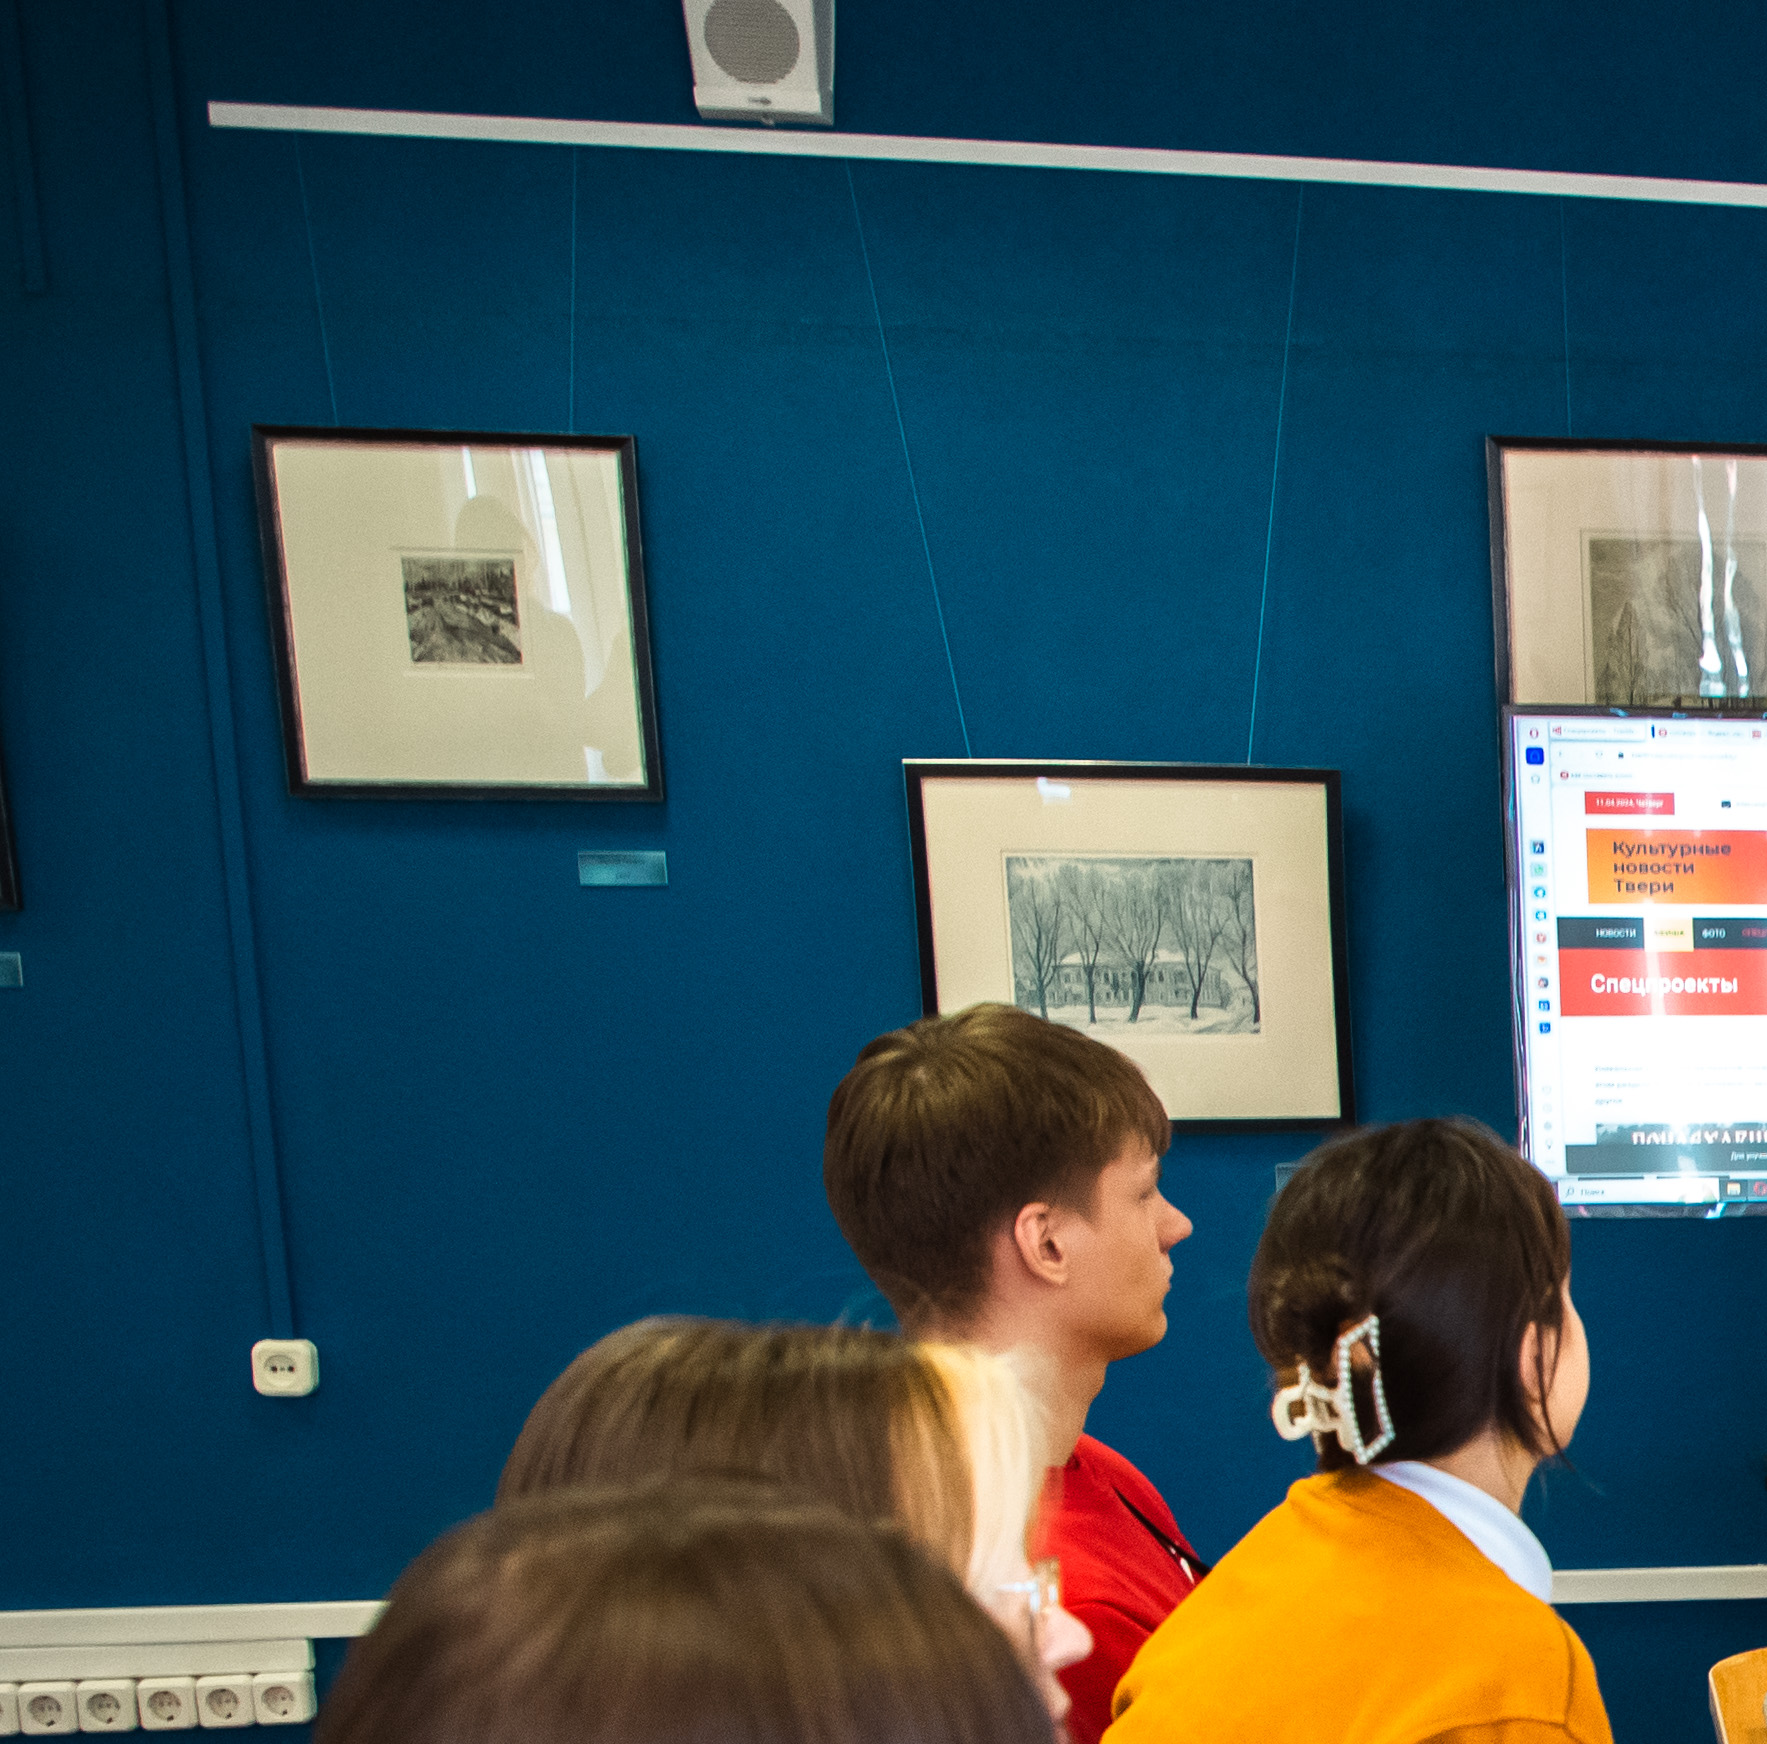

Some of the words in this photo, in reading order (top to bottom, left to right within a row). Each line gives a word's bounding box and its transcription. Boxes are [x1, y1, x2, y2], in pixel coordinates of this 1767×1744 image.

[1612, 841, 1732, 858] Культурные
[1613, 860, 1695, 876] новости
[1614, 879, 1675, 895] Твери
[1590, 973, 1739, 997] Спецпроекты
